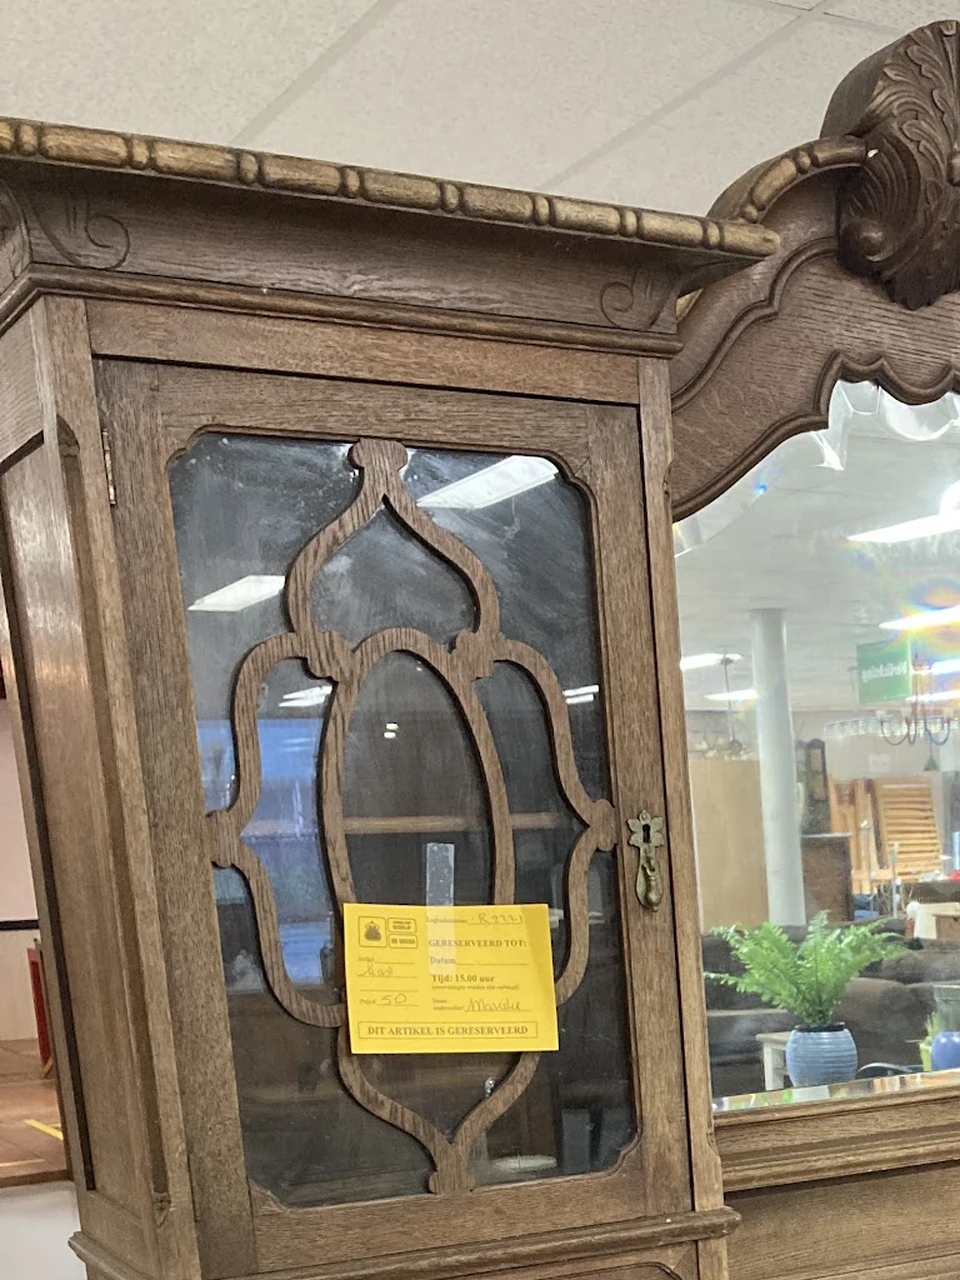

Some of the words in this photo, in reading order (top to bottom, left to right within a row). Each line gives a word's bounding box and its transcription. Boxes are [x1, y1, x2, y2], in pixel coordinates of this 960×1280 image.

[428, 939, 502, 948] GERESERVEERD
[504, 939, 527, 948] TOT:
[430, 957, 456, 965] Datum
[431, 974, 453, 984] Tijd:
[455, 974, 477, 982] 15.00
[368, 1026, 386, 1035] DIT
[388, 1027, 433, 1035] ARTIKEL
[435, 1027, 446, 1035] IS
[447, 1026, 528, 1035] GERESERVEERD
